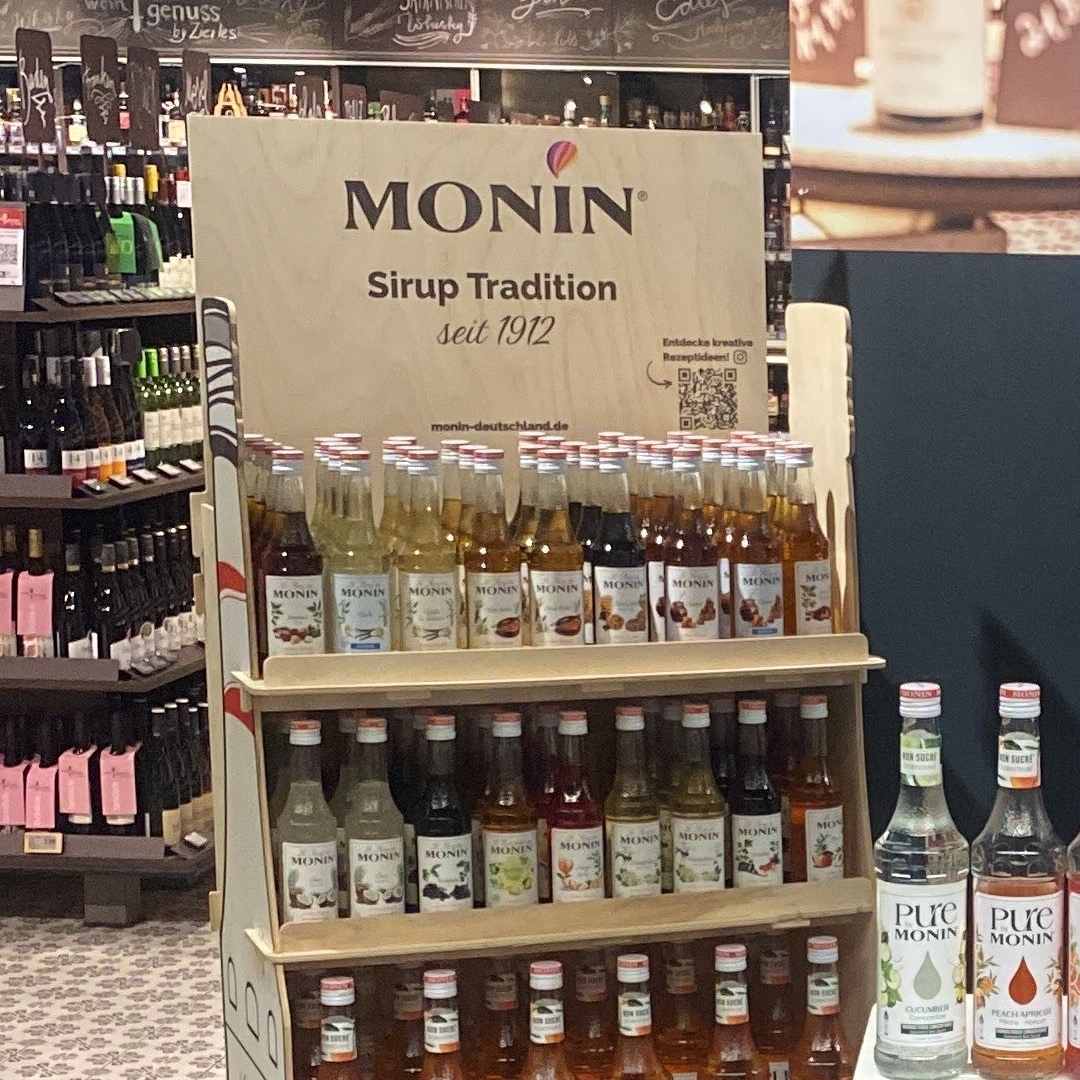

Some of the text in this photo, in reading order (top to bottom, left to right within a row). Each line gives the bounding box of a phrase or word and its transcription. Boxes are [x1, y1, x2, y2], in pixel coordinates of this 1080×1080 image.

[147, 4, 221, 26] genuss
[344, 179, 634, 236] MONIN
[368, 271, 617, 307] Sirup Tradition
[437, 315, 555, 345] seit 1912
[663, 338, 753, 347] Entdecke kreative
[663, 353, 729, 363] Rezeptideen!
[431, 420, 568, 432] monin-deutschland.de
[603, 580, 643, 589] MONIN
[672, 579, 713, 588] MONIN
[743, 576, 780, 585] MONIN
[341, 588, 385, 598] MONIN
[409, 587, 452, 596] MONIN
[476, 585, 518, 595] MONIN
[536, 583, 578, 593] MONIN
[273, 589, 318, 599] MONIN
[679, 831, 719, 841] MONIN
[738, 827, 777, 837] MONIN
[620, 835, 659, 845] MONIN
[490, 844, 532, 855] MONIN
[560, 840, 600, 851] MONIN
[357, 851, 400, 862] MONIN
[425, 849, 468, 859] MONIN
[291, 855, 335, 866] MONIN
[895, 928, 957, 942] MONIN
[991, 932, 1053, 946] MONIN
